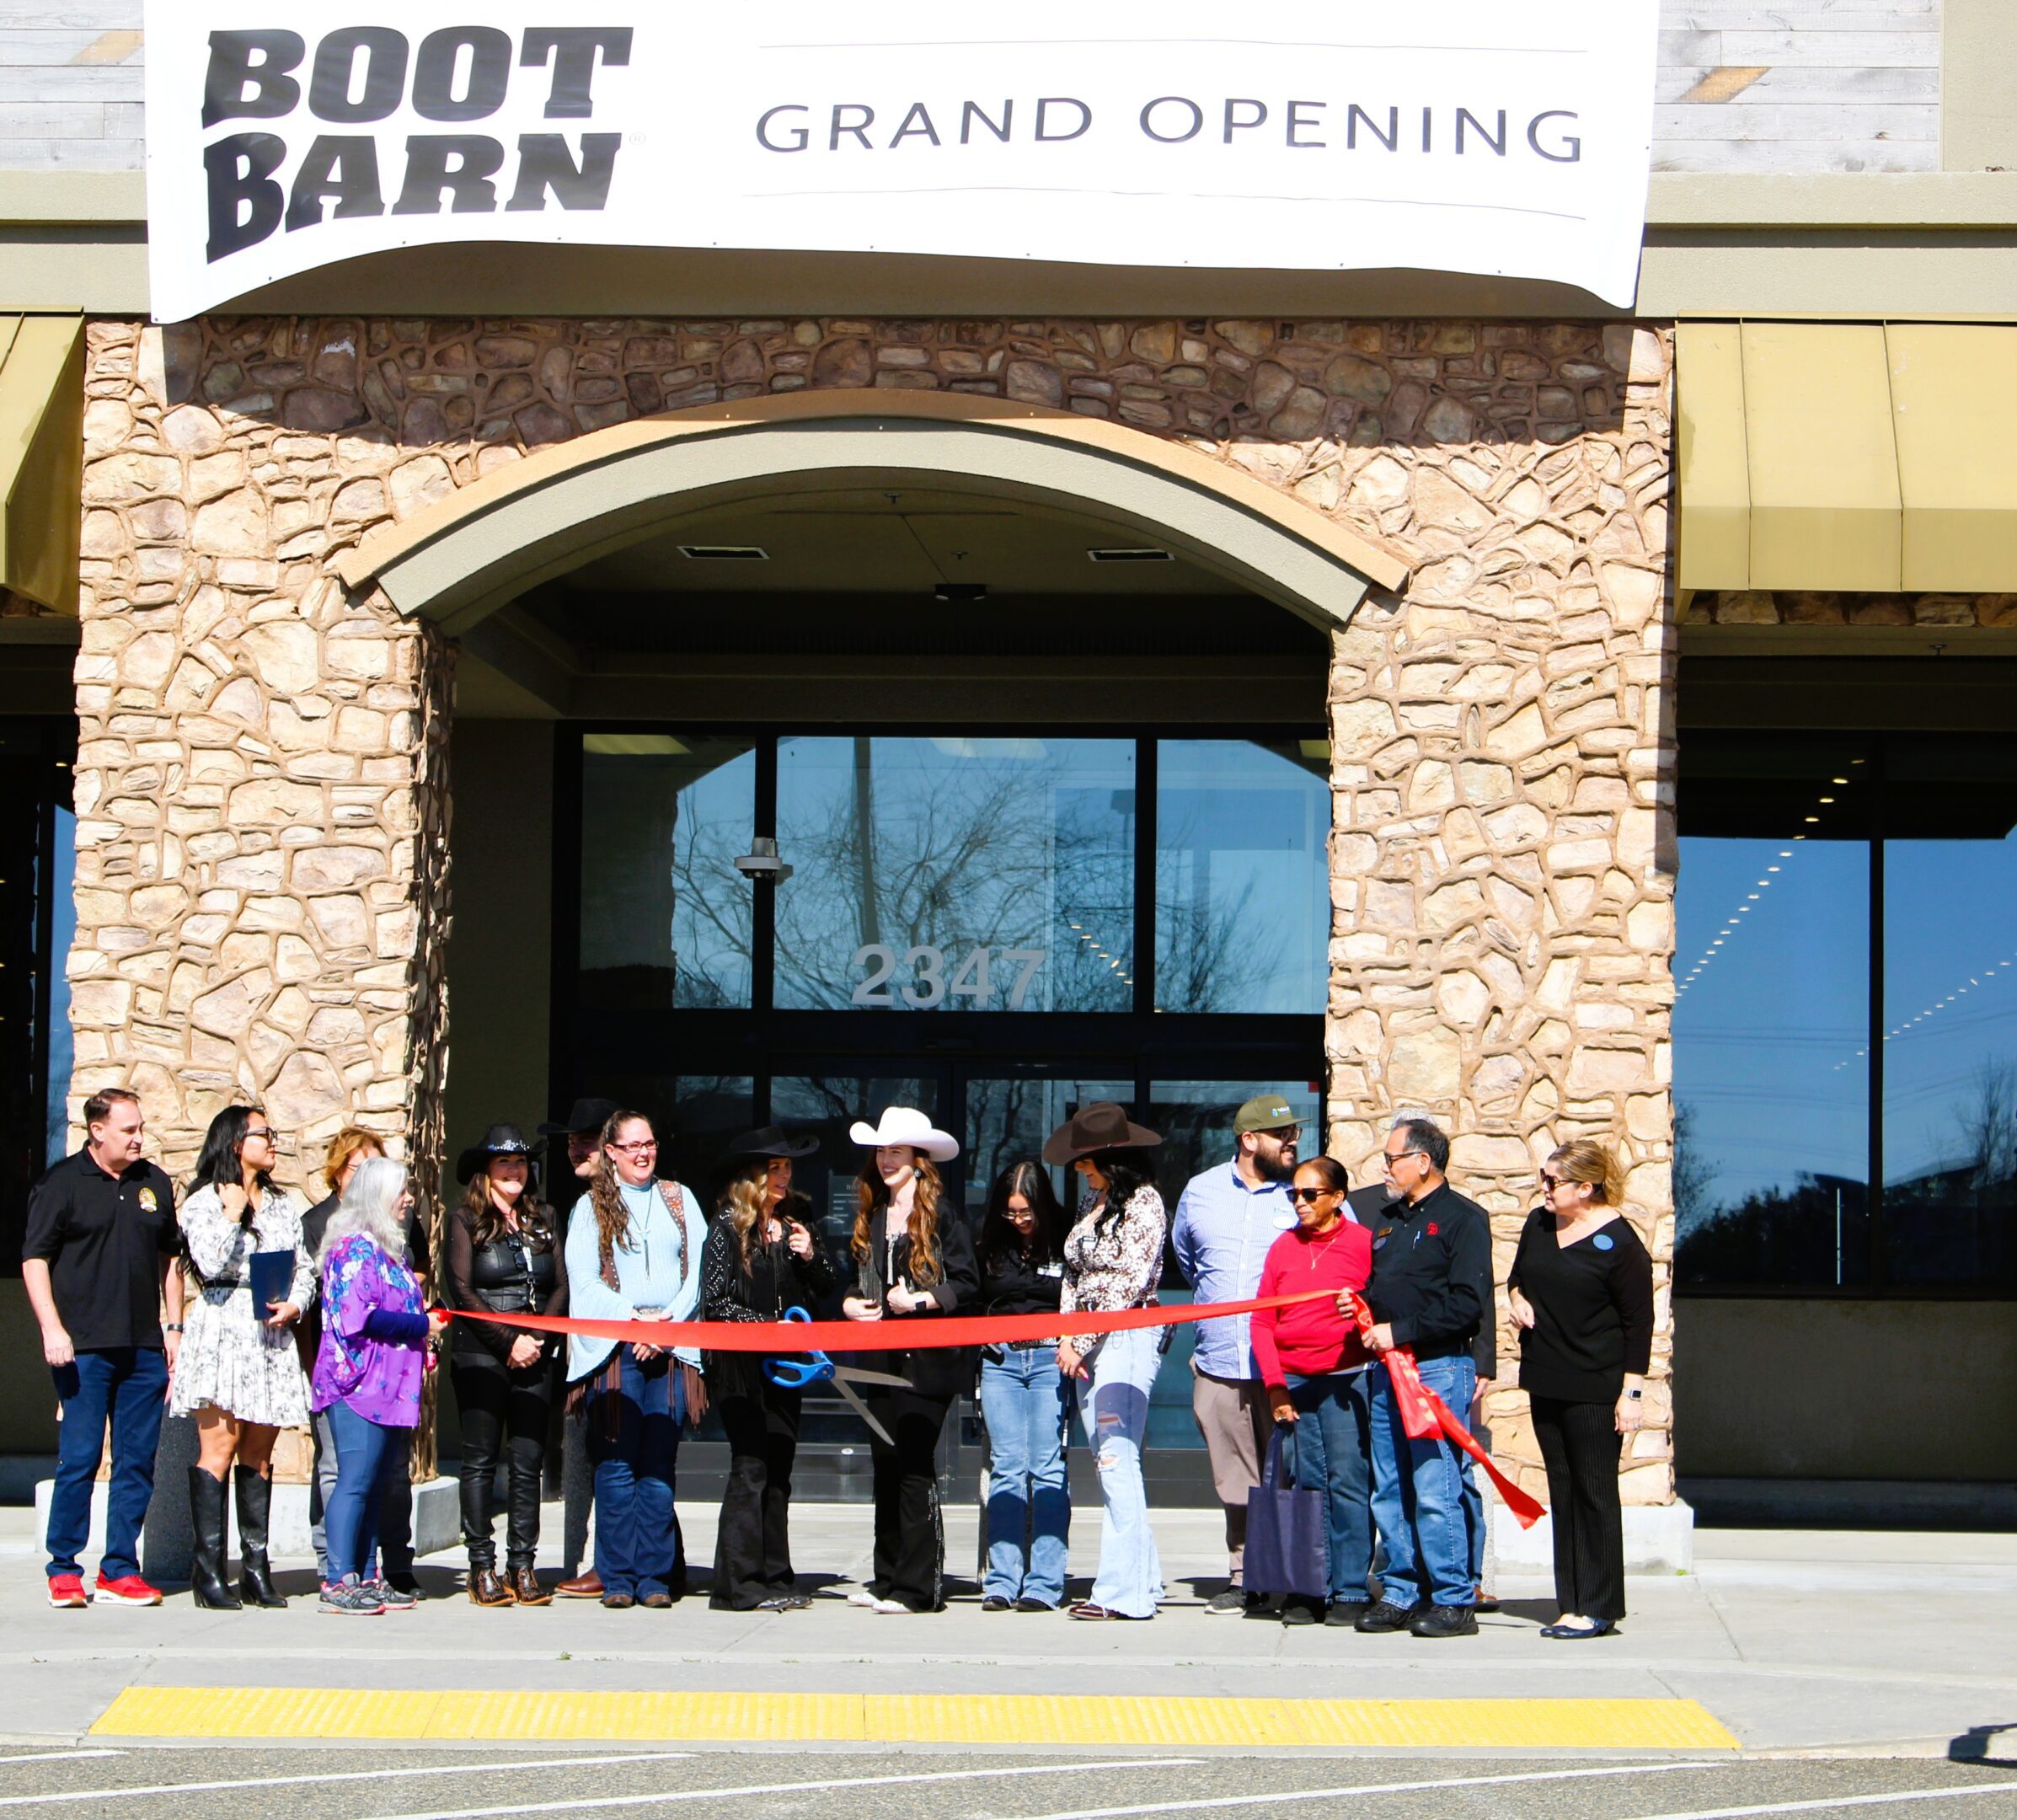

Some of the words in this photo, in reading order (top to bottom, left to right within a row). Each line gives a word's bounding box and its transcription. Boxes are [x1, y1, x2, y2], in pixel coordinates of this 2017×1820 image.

[201, 26, 634, 129] BOOT
[756, 98, 1092, 153] GRAND
[1140, 97, 1581, 162] OPENING
[203, 132, 622, 265] BARN
[851, 944, 1045, 1008] 2347
